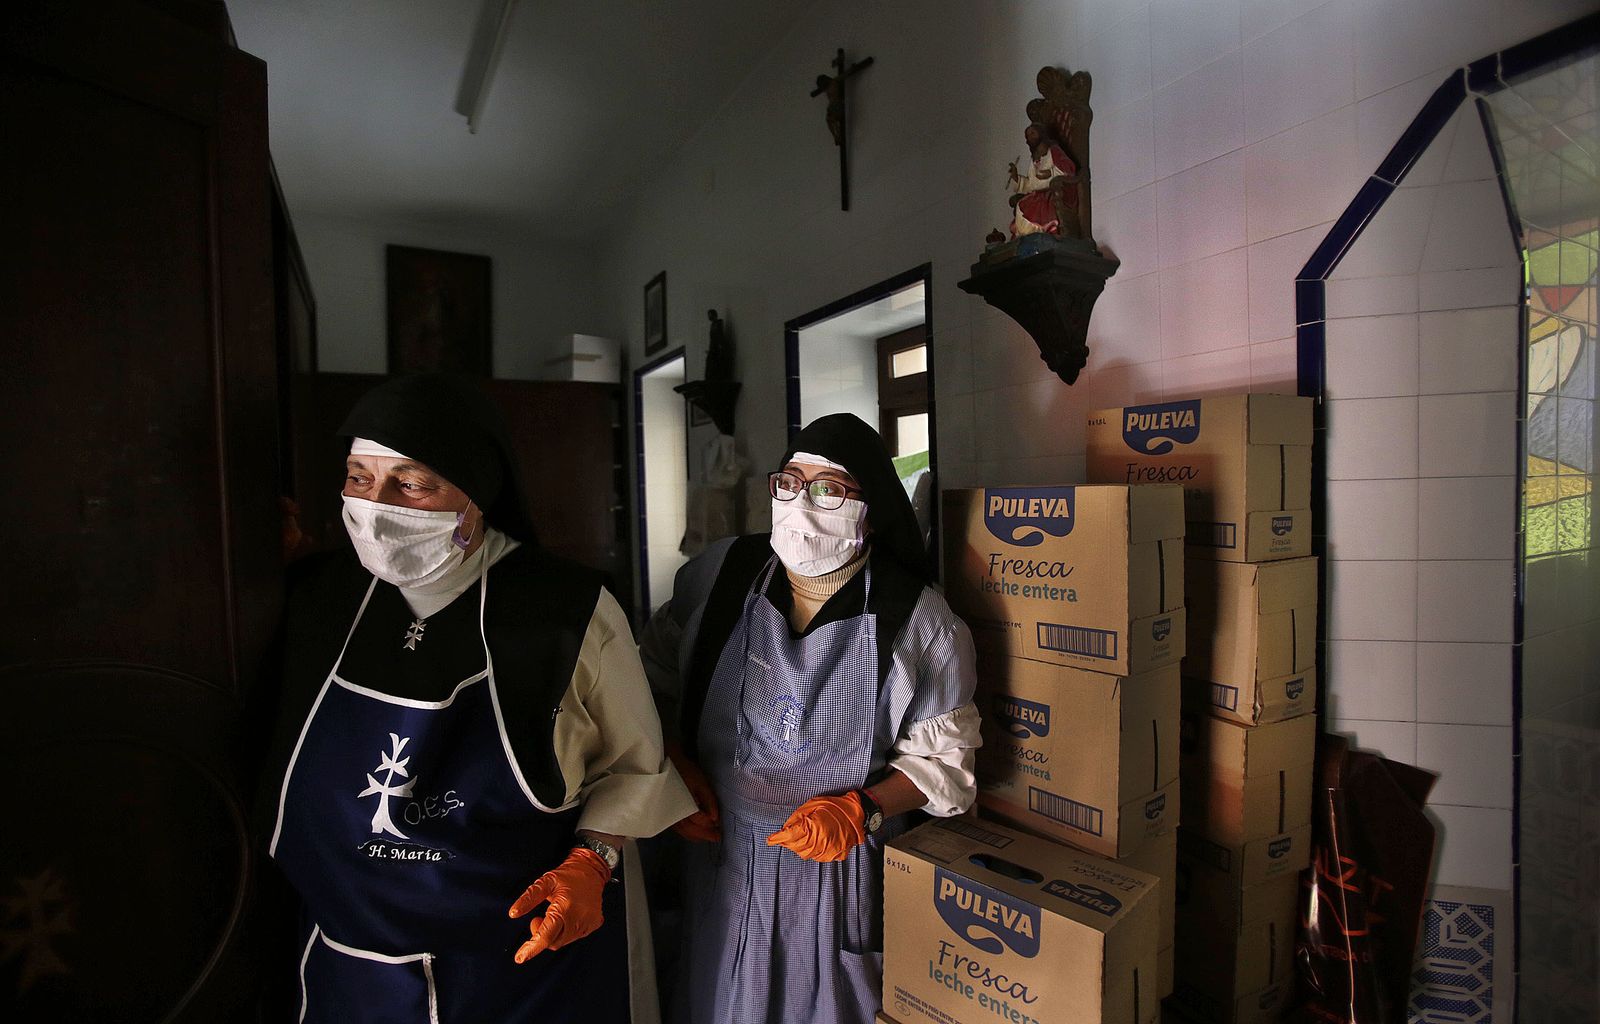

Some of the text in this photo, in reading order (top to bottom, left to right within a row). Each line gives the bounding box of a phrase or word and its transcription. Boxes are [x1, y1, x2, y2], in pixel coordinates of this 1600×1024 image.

[1126, 408, 1196, 432] PULEVA
[1126, 462, 1200, 484] Fresca
[988, 495, 1070, 519] PULEVA
[988, 552, 1075, 578] Fresca
[980, 576, 1078, 603] leche entera
[998, 701, 1047, 727] ULEVA
[1016, 762, 1052, 781] entera
[368, 844, 387, 859] H.
[939, 876, 1034, 940] PULEVA
[1050, 883, 1117, 912] PULEVA
[929, 959, 975, 1000] leche
[938, 940, 1039, 1004] Fresca
